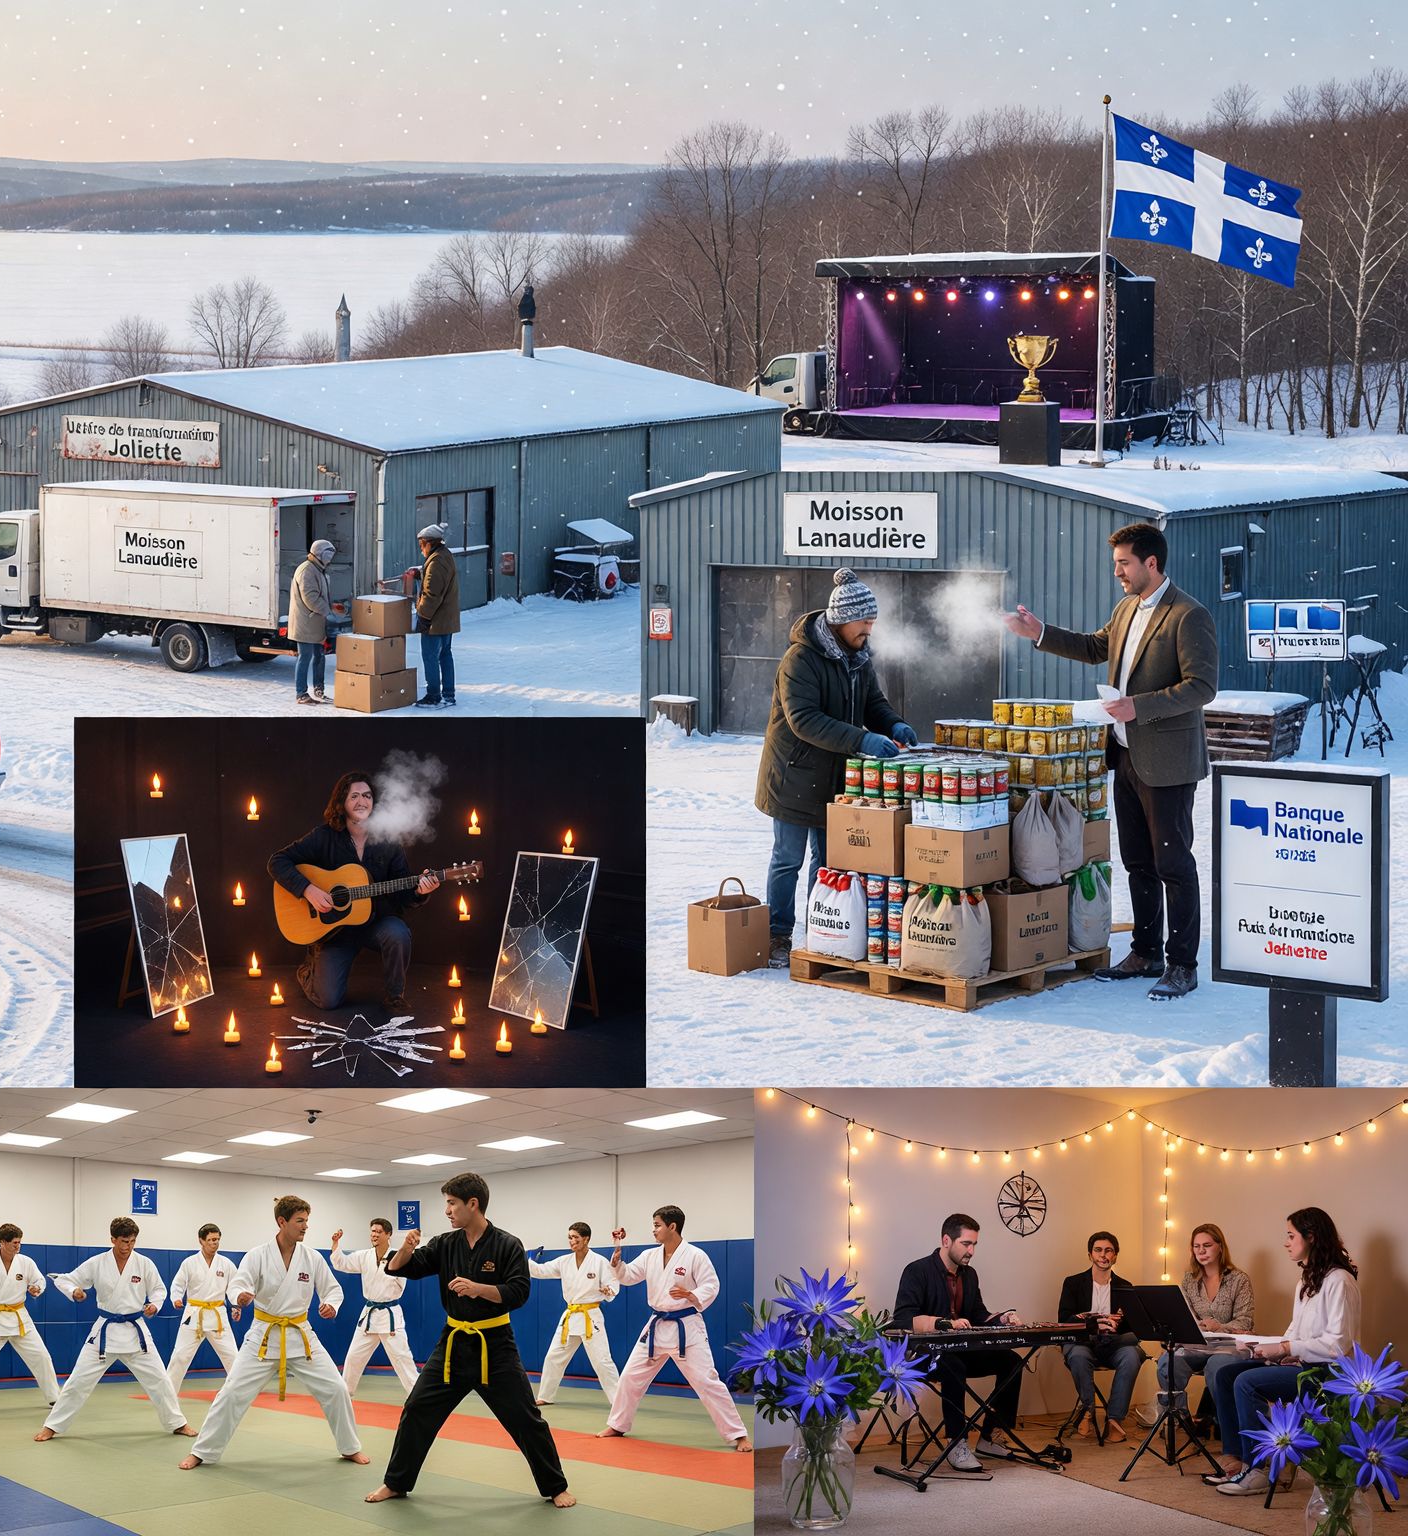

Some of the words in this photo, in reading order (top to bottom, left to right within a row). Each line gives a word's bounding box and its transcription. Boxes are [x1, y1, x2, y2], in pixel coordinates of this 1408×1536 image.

[109, 438, 182, 461] Joliette
[810, 500, 904, 521] Moisson
[125, 531, 185, 550] Moisson
[798, 526, 926, 549] Lanaudière
[118, 549, 198, 569] Lanaudière
[1275, 801, 1345, 825] Banque
[1274, 822, 1364, 845] Nationale
